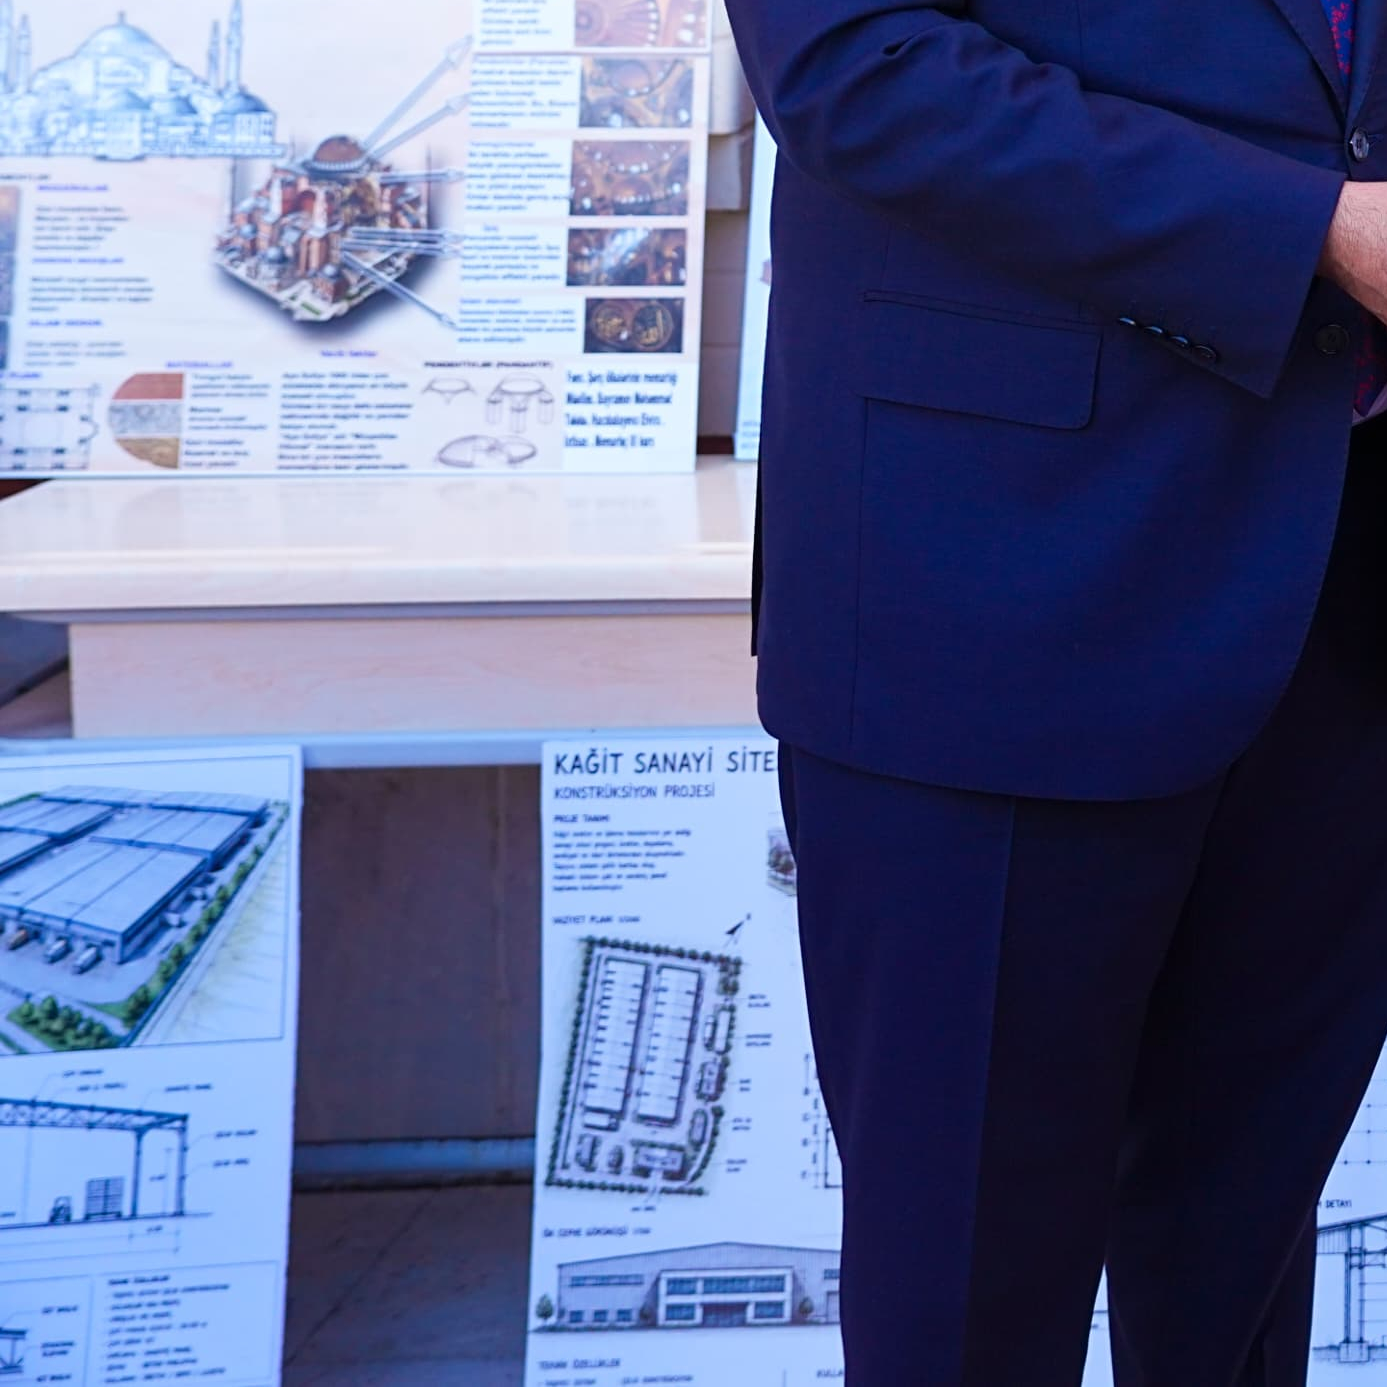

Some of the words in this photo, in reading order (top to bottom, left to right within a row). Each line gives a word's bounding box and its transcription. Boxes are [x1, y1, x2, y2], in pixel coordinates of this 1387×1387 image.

[554, 748, 623, 774] KAĞİT
[634, 747, 714, 773] SANAYİ
[726, 746, 778, 773] SİTE
[664, 782, 715, 798] PROJESİ
